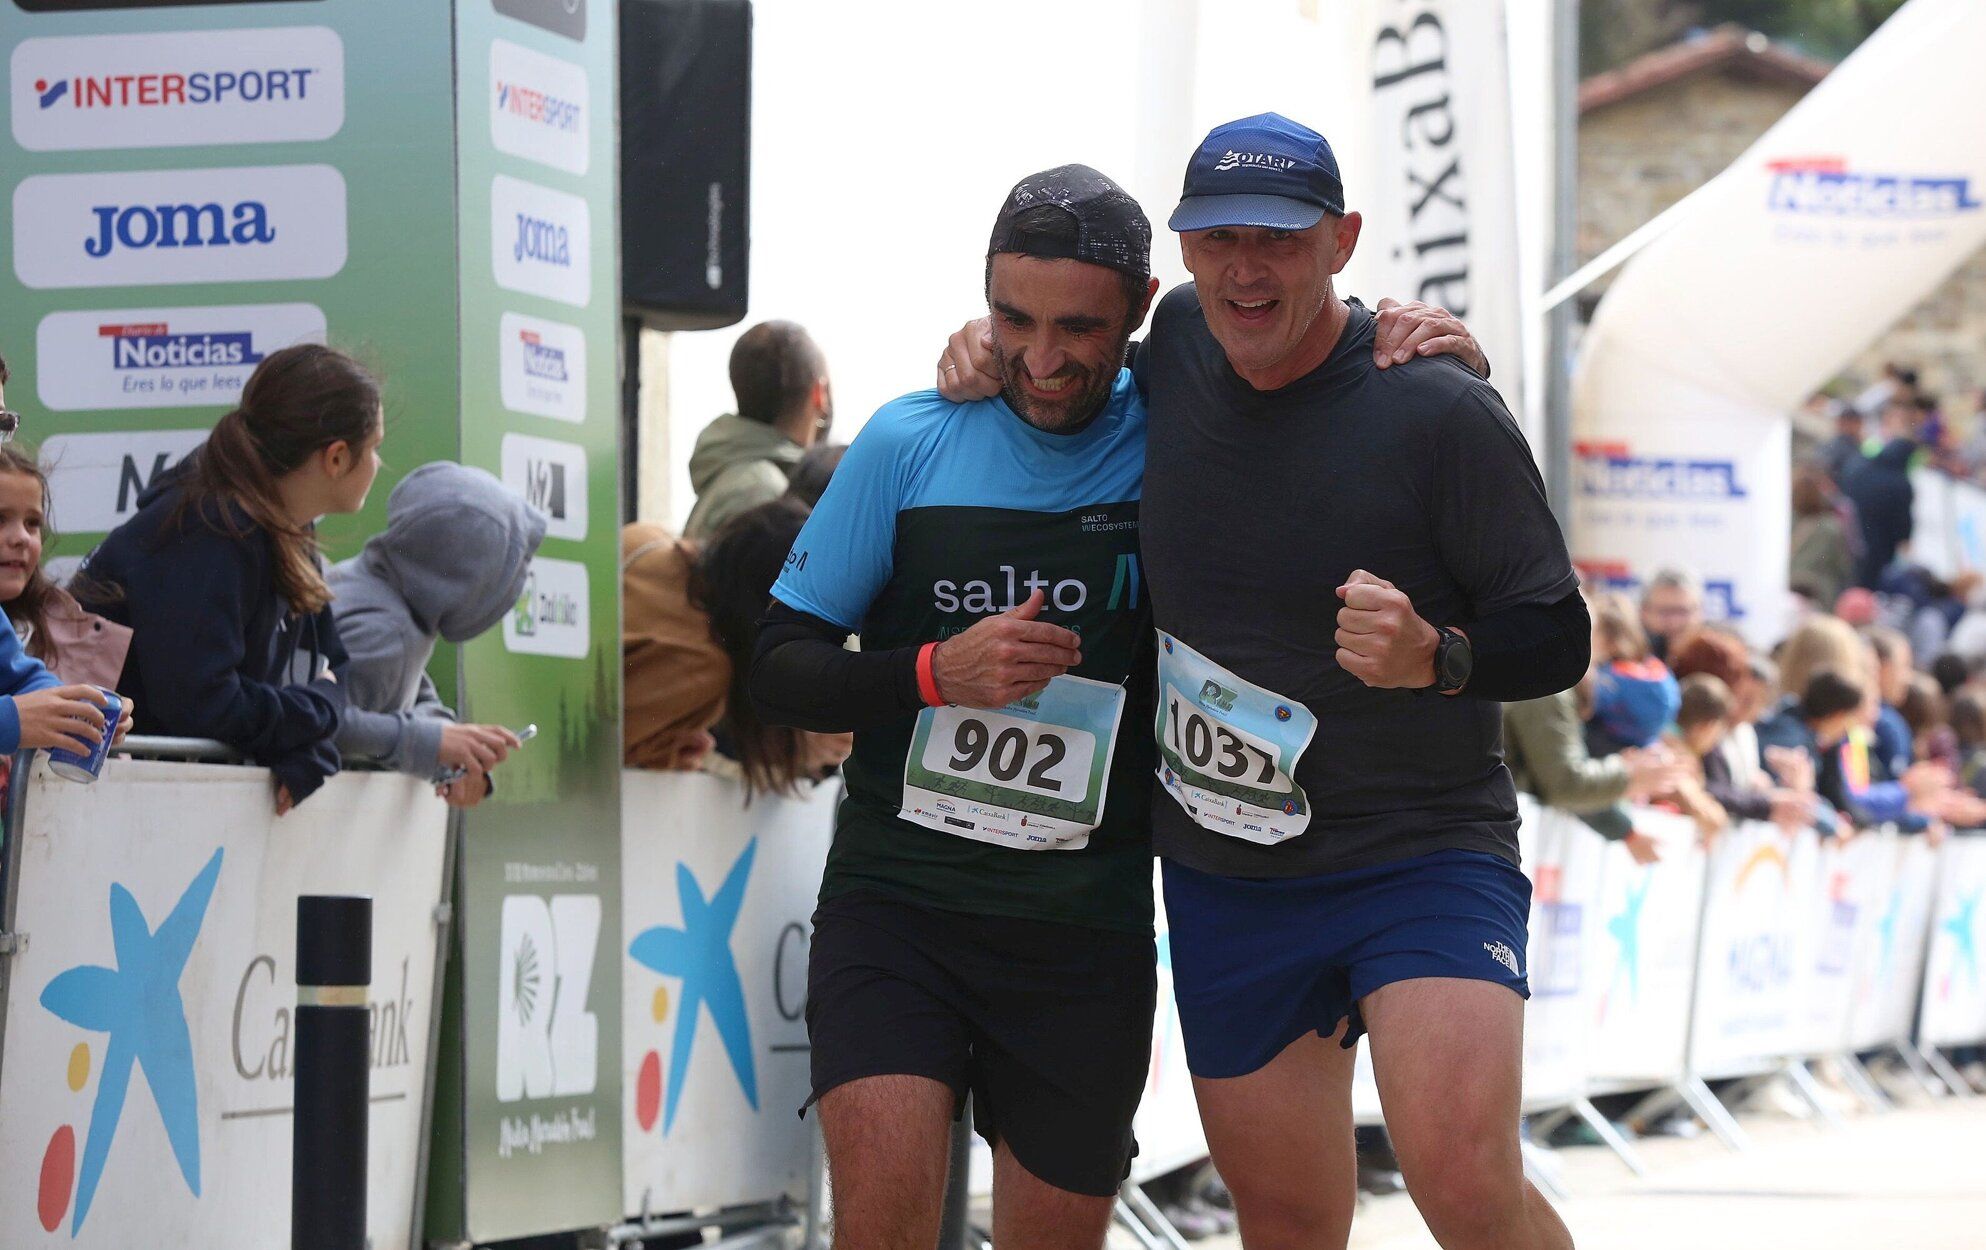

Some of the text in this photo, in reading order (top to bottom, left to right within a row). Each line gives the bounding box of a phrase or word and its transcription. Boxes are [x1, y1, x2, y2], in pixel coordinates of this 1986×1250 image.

[74, 69, 312, 108] INTERSPORT
[509, 86, 580, 132] INTERSPORT
[119, 336, 243, 367] Noticias
[123, 373, 241, 395] Eres lo que lees
[1081, 514, 1107, 523] SALTO
[933, 565, 1087, 613] salto
[1171, 698, 1276, 784] 1037
[948, 719, 1066, 792] 902
[1208, 814, 1236, 826] INTERSPORT
[987, 828, 1019, 837] INTERSPORT
[1483, 942, 1510, 961] NORTH
[1496, 941, 1510, 954] THE
[1492, 952, 1510, 967] FACE
